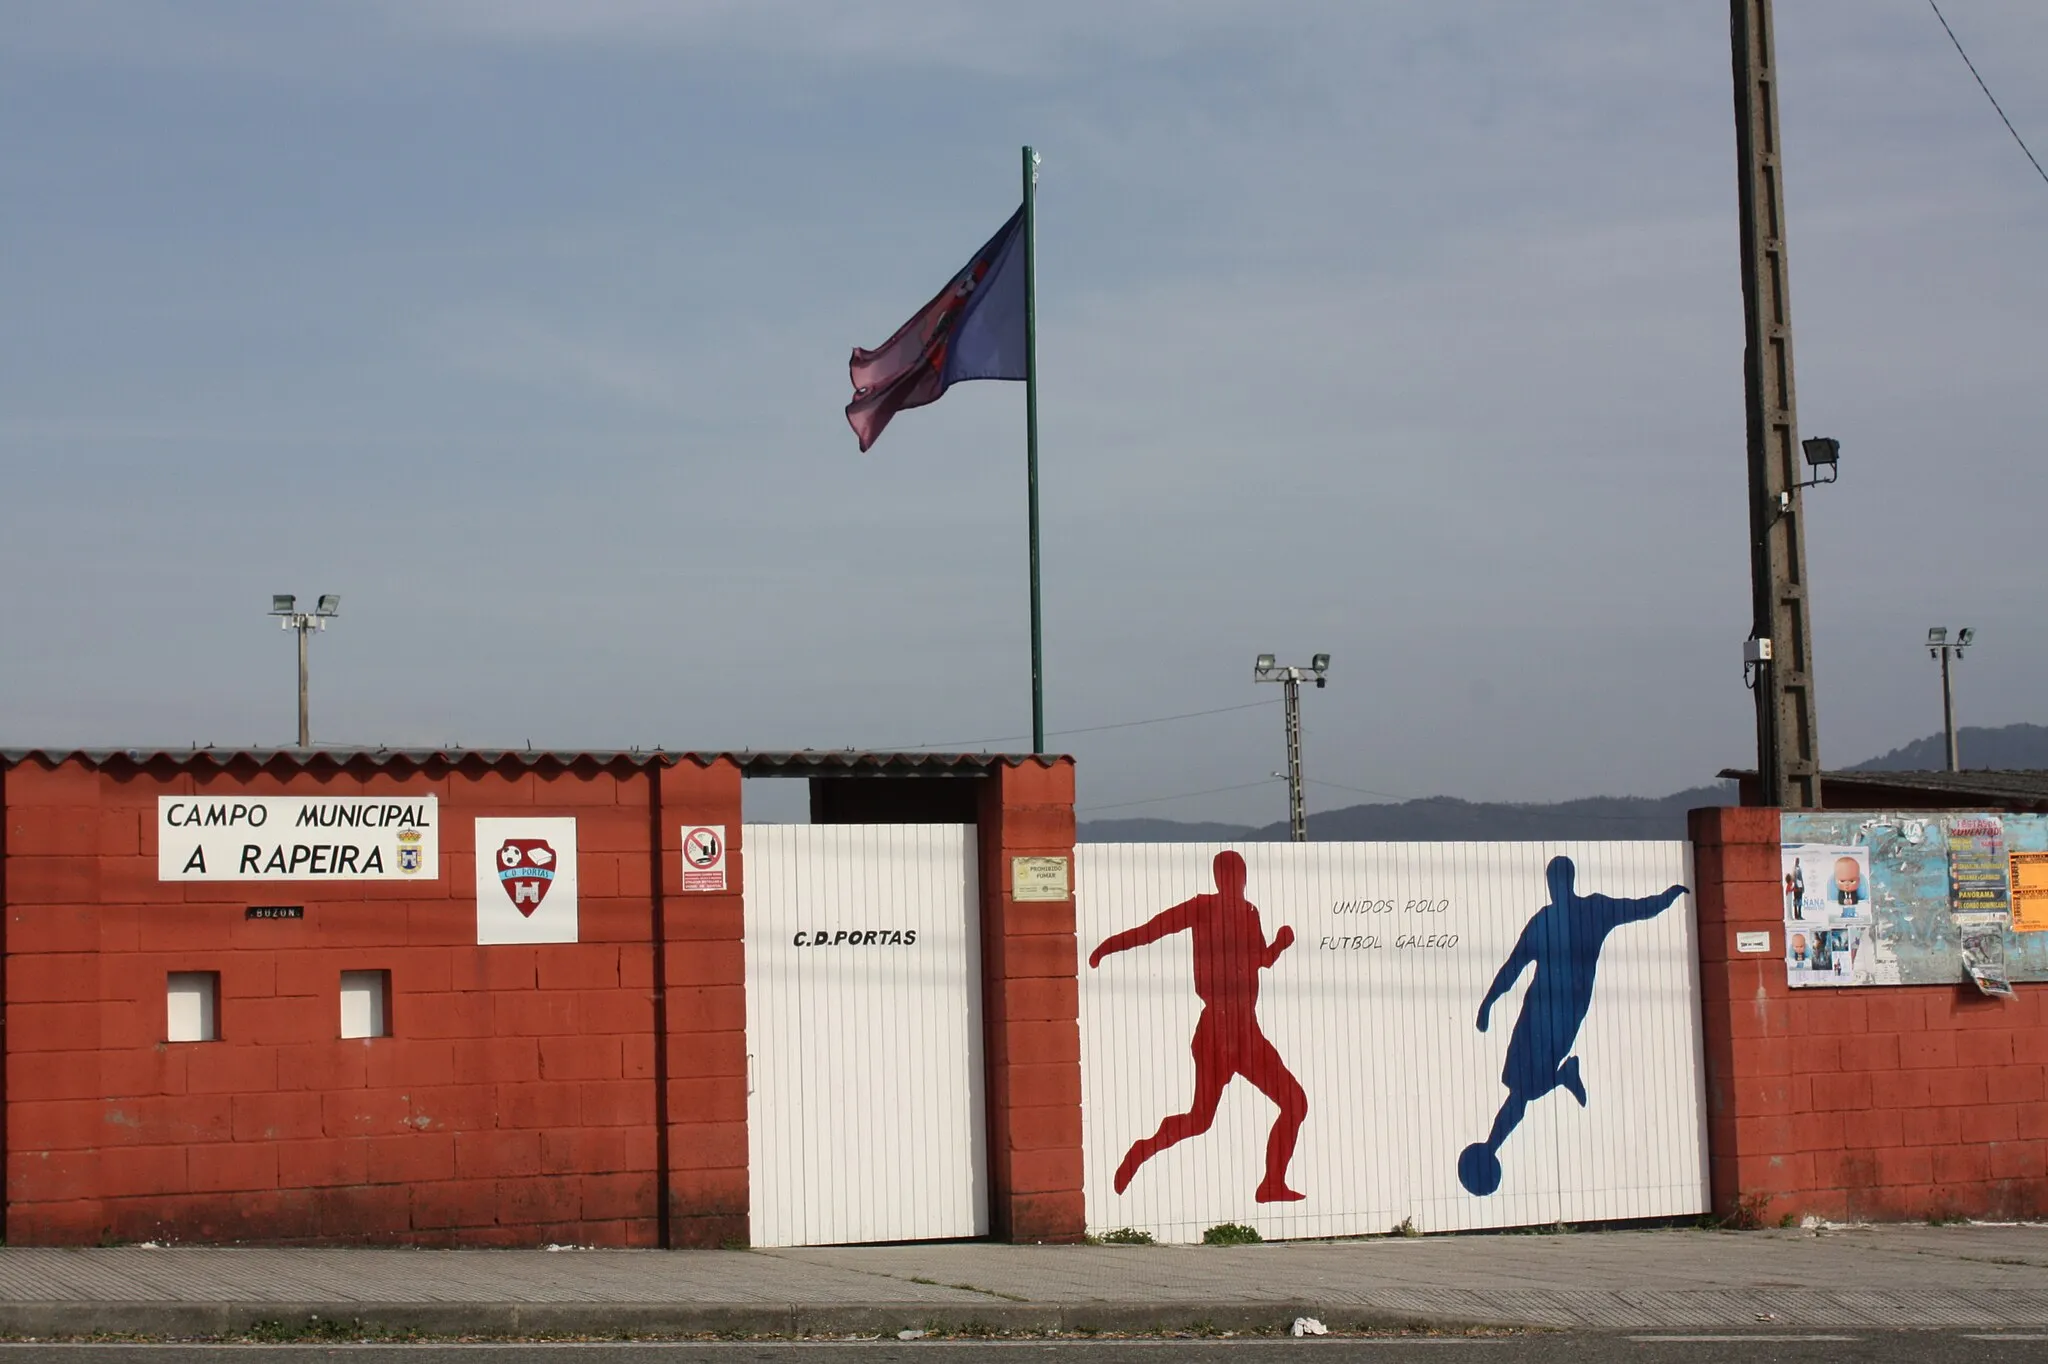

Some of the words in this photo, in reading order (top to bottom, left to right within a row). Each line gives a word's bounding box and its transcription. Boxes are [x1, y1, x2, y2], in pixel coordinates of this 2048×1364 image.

[167, 803, 268, 827] CAMPO
[295, 804, 430, 827] MUNICIPAL
[182, 844, 207, 874] A
[239, 844, 384, 874] RAPEIRA
[521, 867, 549, 878] PORTAS
[256, 908, 295, 918] BUZON
[1333, 900, 1395, 914] UNIDOS
[1404, 899, 1449, 913] POLO
[793, 930, 916, 947] C.D.PORTAS
[1319, 935, 1382, 950] FUTBOL
[1395, 934, 1459, 949] GALEGO
